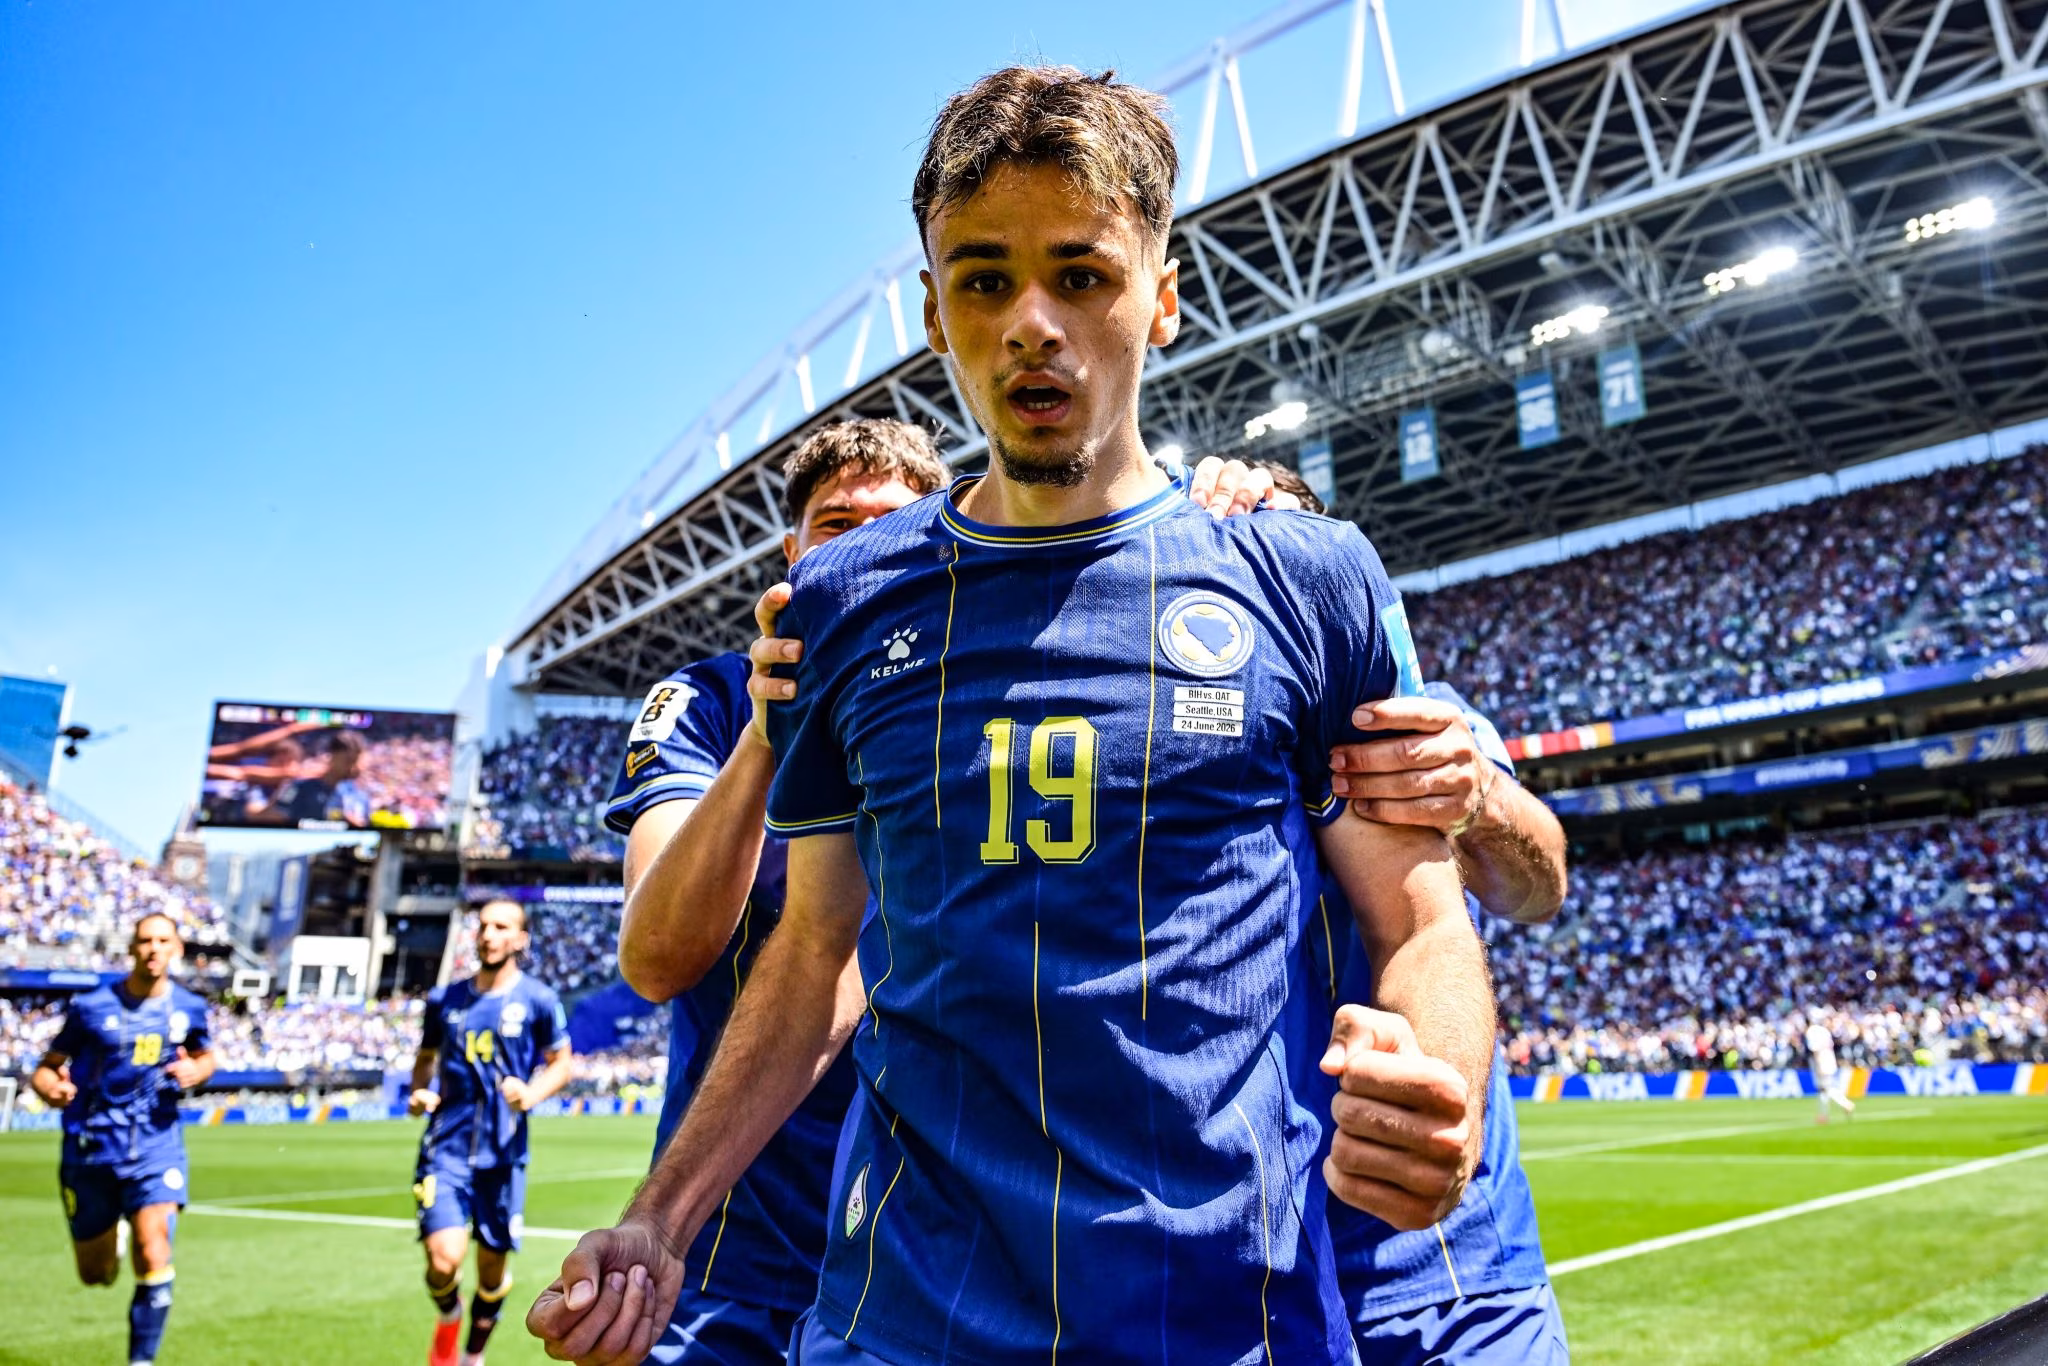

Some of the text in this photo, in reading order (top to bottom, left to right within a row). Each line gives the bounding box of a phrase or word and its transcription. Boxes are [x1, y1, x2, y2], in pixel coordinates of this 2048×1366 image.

[871, 657, 926, 679] KELME
[1188, 689, 1231, 701] BIH vs. QAT
[1181, 719, 1236, 733] 24 June 2026
[1216, 706, 1233, 717] USA
[980, 716, 1099, 864] 19
[465, 1029, 493, 1063] 14
[1584, 1072, 1650, 1101] VISA
[1733, 1070, 1805, 1099] VISA
[1896, 1062, 1980, 1098] VISA
